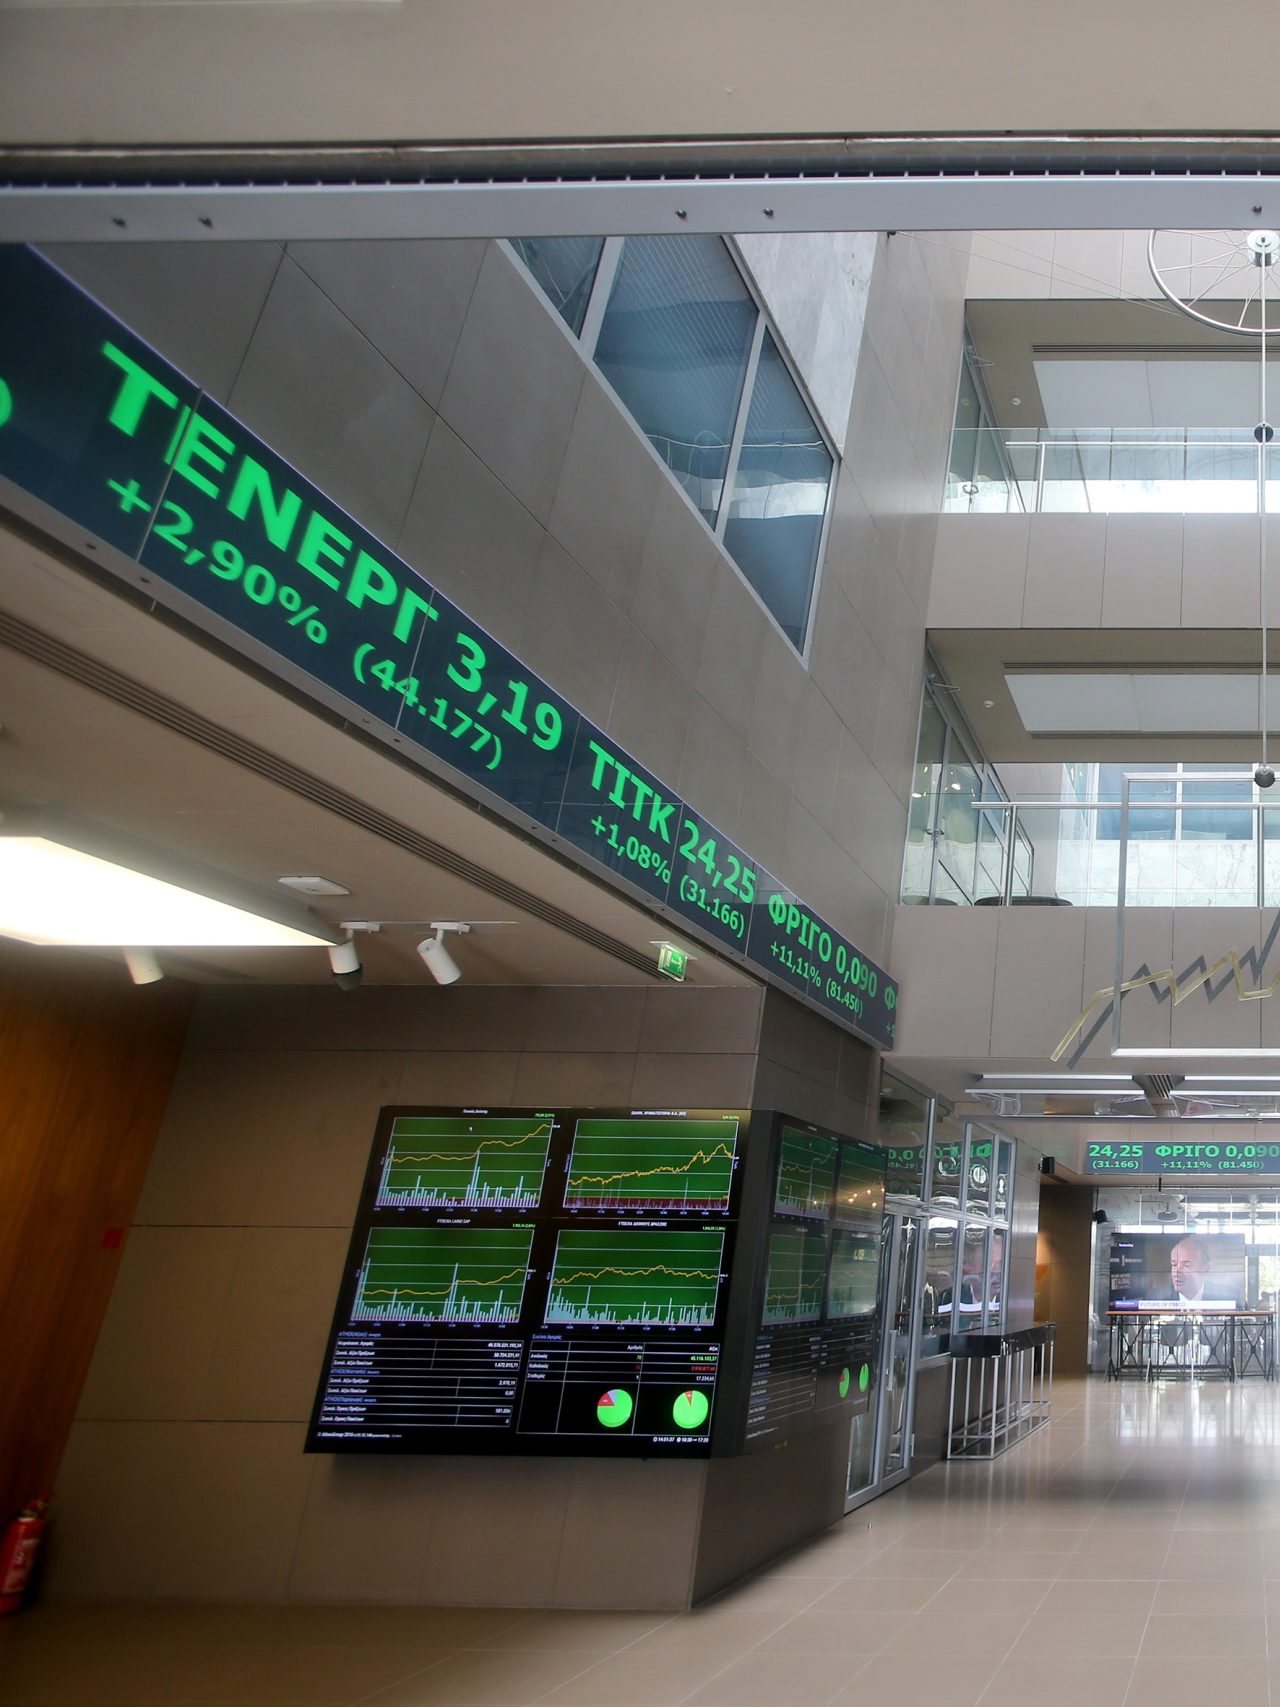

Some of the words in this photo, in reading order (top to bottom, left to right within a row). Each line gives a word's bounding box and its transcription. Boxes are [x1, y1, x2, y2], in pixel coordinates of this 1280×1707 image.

[103, 342, 440, 643] ΤΕΝΕΡΓ
[447, 632, 563, 752] 3,19
[589, 740, 676, 844] ΤΙΤΚ
[679, 819, 757, 905] 24,25
[768, 894, 832, 962] ΦΡΙΓΟ
[836, 945, 877, 998] 0,090
[107, 478, 329, 646] +2,90%
[352, 643, 503, 770] (44.177)
[591, 815, 671, 884] +1,08%
[679, 874, 746, 939] (31.166)
[770, 940, 822, 987] +11,11%
[825, 978, 863, 1019] (81.450)
[1088, 1144, 1143, 1159] 24,25
[1154, 1144, 1220, 1158] ΦΡΙΓΟ
[1225, 1144, 1280, 1159] 0,090
[1092, 1160, 1139, 1169] (31.166)
[1161, 1160, 1212, 1169] +11,11%
[1218, 1160, 1265, 1169] (81.450)
